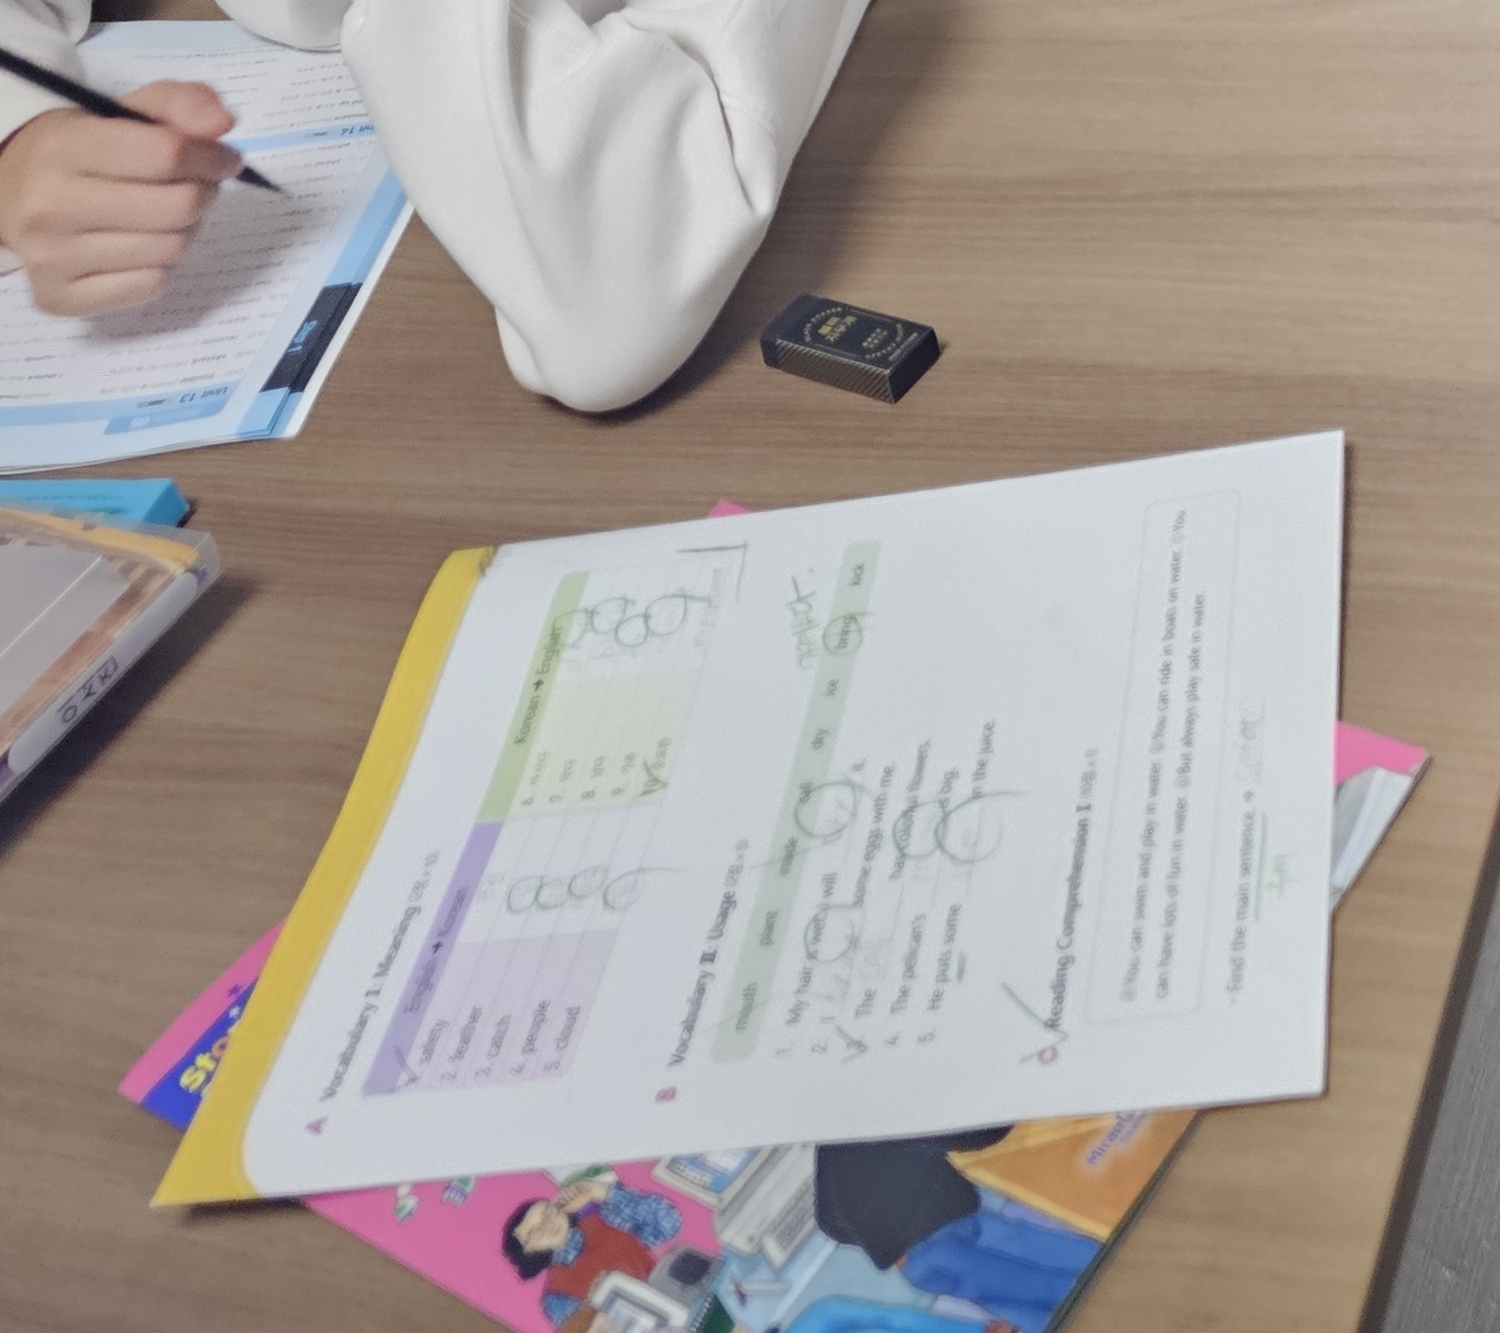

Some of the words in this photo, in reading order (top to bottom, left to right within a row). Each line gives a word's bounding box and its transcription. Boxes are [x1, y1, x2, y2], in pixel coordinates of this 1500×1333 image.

[179, 392, 196, 403] 13
[200, 386, 229, 399] Unit
[1165, 606, 1177, 640] boats
[513, 695, 541, 744] Korean
[536, 624, 564, 675] English
[1161, 660, 1172, 683] ride
[1160, 690, 1169, 711] can
[981, 718, 996, 756] juice.
[1180, 708, 1198, 749] always
[972, 758, 989, 782] the
[735, 981, 759, 1031] mouth
[760, 910, 780, 947] plant
[811, 729, 830, 750] dry
[826, 679, 839, 697] ice
[835, 615, 858, 651] bring
[851, 563, 865, 586] kick
[871, 791, 889, 826] with
[863, 828, 884, 865] eggs
[1142, 820, 1156, 848] play
[1240, 809, 1255, 876] sentence
[1056, 817, 1089, 951] Comprehension
[1138, 851, 1151, 880] and
[1169, 855, 1181, 880] fun
[853, 866, 871, 907] some
[1133, 885, 1147, 922] swim
[1236, 882, 1250, 920] main
[797, 967, 813, 996] hair
[820, 872, 838, 899] will
[942, 903, 962, 947] some
[1162, 903, 1176, 930] lots
[1130, 927, 1143, 952] can
[1158, 931, 1174, 968] have
[1230, 925, 1247, 952] the
[667, 970, 715, 1068] Vocabulary
[708, 890, 737, 941] Usage
[891, 985, 911, 1016] The
[902, 912, 928, 982] pelican's
[935, 948, 953, 984] puts
[320, 1002, 379, 1102] Vocabulary
[374, 906, 421, 978] Meaning
[402, 958, 438, 1014] English
[856, 988, 876, 1019] The
[926, 988, 945, 1011] He
[1044, 954, 1075, 1030] Reading
[1157, 974, 1169, 999] can
[420, 1019, 450, 1066] safety
[449, 1006, 482, 1064] feather
[486, 1015, 513, 1060] catch
[521, 999, 551, 1056] people
[556, 1006, 581, 1052] cloud
